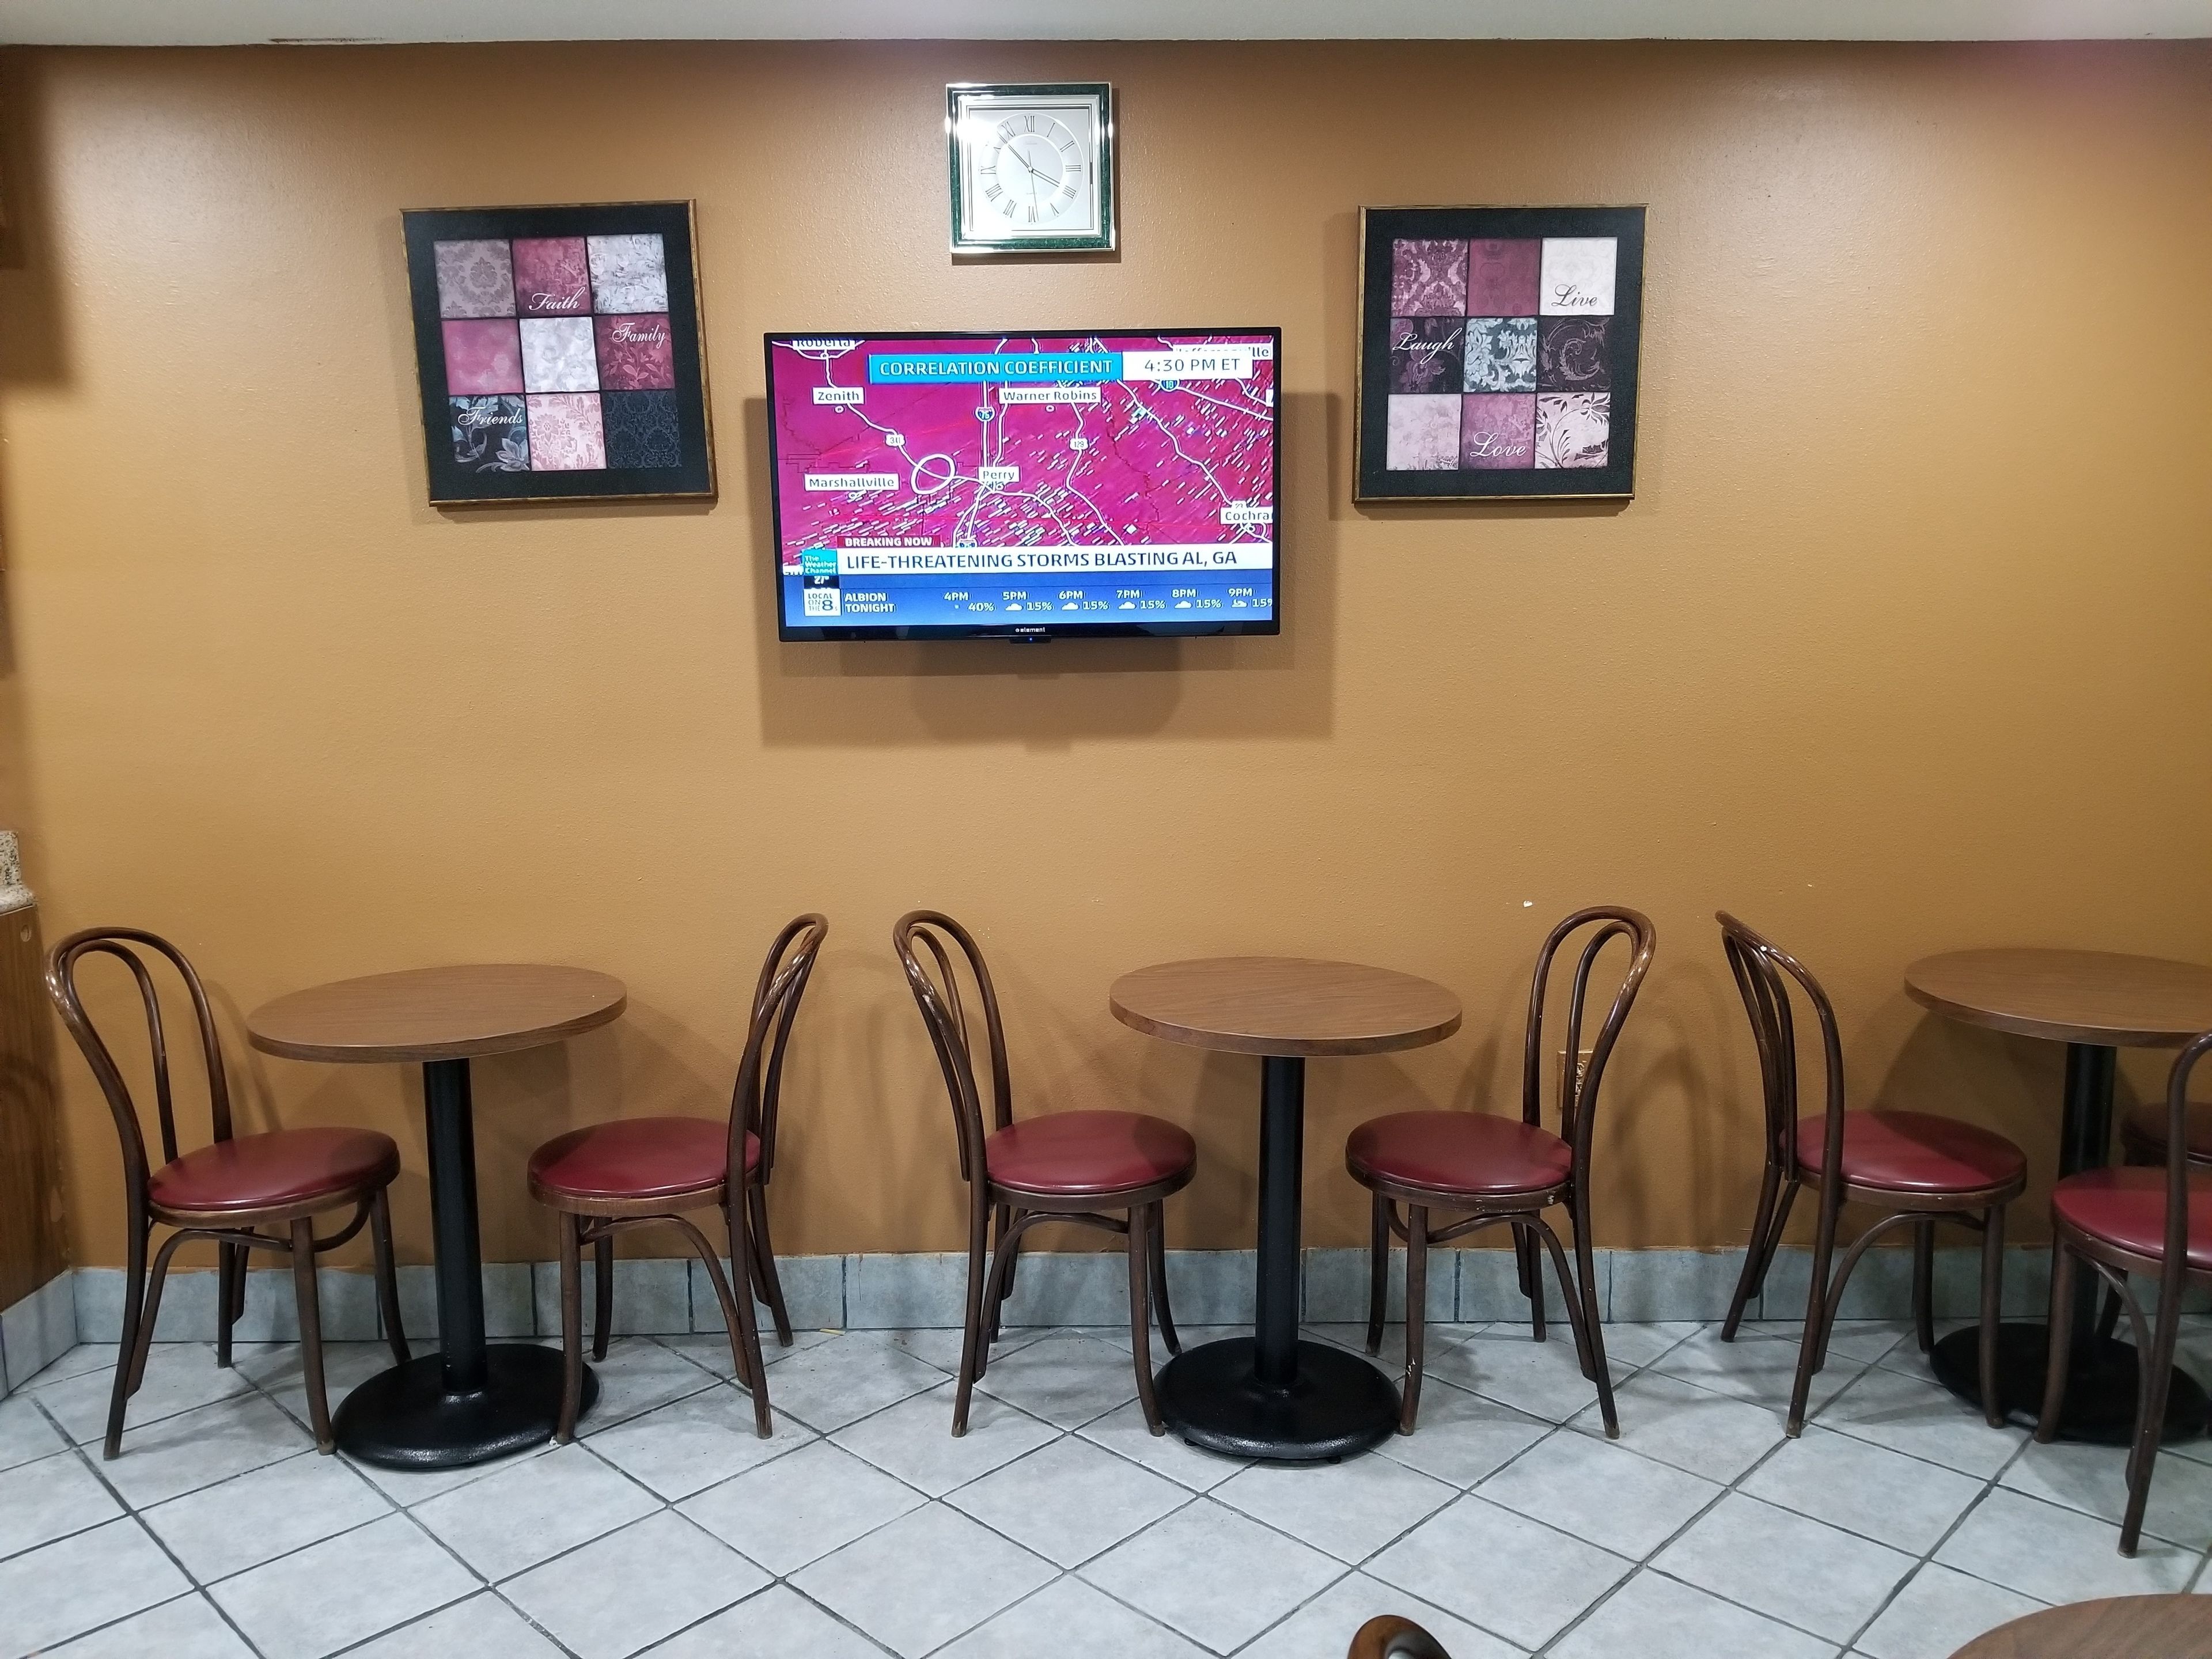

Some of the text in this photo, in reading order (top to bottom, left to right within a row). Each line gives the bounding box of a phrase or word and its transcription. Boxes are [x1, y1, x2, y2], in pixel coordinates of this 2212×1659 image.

[528, 287, 585, 310] Faith
[1551, 284, 1598, 307] Live
[612, 323, 666, 349] Family
[1392, 327, 1463, 365] Laugh
[880, 360, 1112, 375] CORRELATION COEFFICIENT
[1145, 358, 1240, 372] 4:30 PM ET
[818, 391, 859, 400] Zenith
[1003, 391, 1097, 400] Warner Robins
[458, 407, 523, 426] Friends
[1469, 431, 1527, 457] Love
[983, 471, 1014, 480] Perry
[809, 478, 894, 487] Marshallville
[845, 537, 933, 547] BREAKING NOW
[847, 551, 1237, 569] LIFE-THREATENING STORMS BLASTING AL, GA
[844, 592, 888, 602] ALBION
[944, 588, 1253, 601] 4PM 5PM 6PM 7PM 8PM 9PM
[845, 603, 896, 613] TONIGHT
[968, 602, 995, 612] 40%
[1027, 601, 1053, 611] 15%
[1083, 601, 1109, 610] 15%
[1140, 600, 1165, 609] 15%
[1196, 599, 1222, 608] 15%
